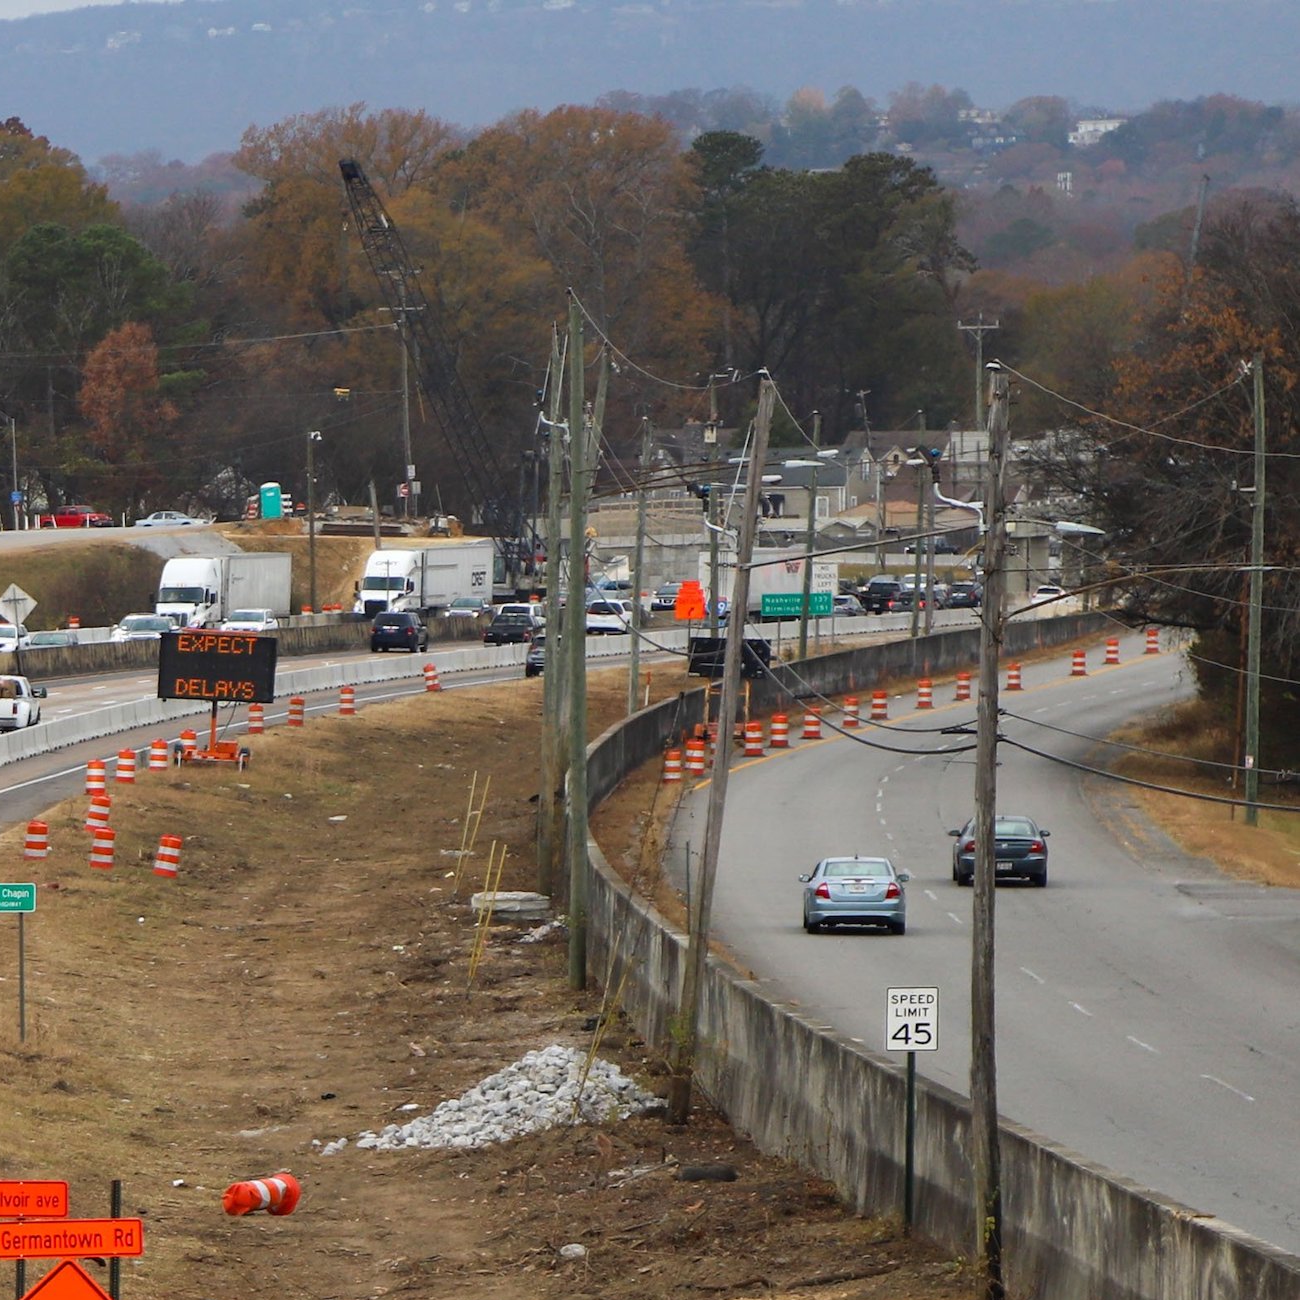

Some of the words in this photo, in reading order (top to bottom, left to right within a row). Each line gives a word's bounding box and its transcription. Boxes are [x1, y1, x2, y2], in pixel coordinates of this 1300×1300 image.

[178, 635, 257, 655] EXPECT
[175, 679, 255, 699] DELAYS
[2, 889, 29, 899] Chapin
[891, 994, 935, 1004] SPEED
[895, 1008, 929, 1017] LIMIT
[892, 1023, 932, 1045] 45
[36, 1194, 60, 1208] ave
[1, 1230, 103, 1250] Germantown
[114, 1229, 134, 1247] Rd
